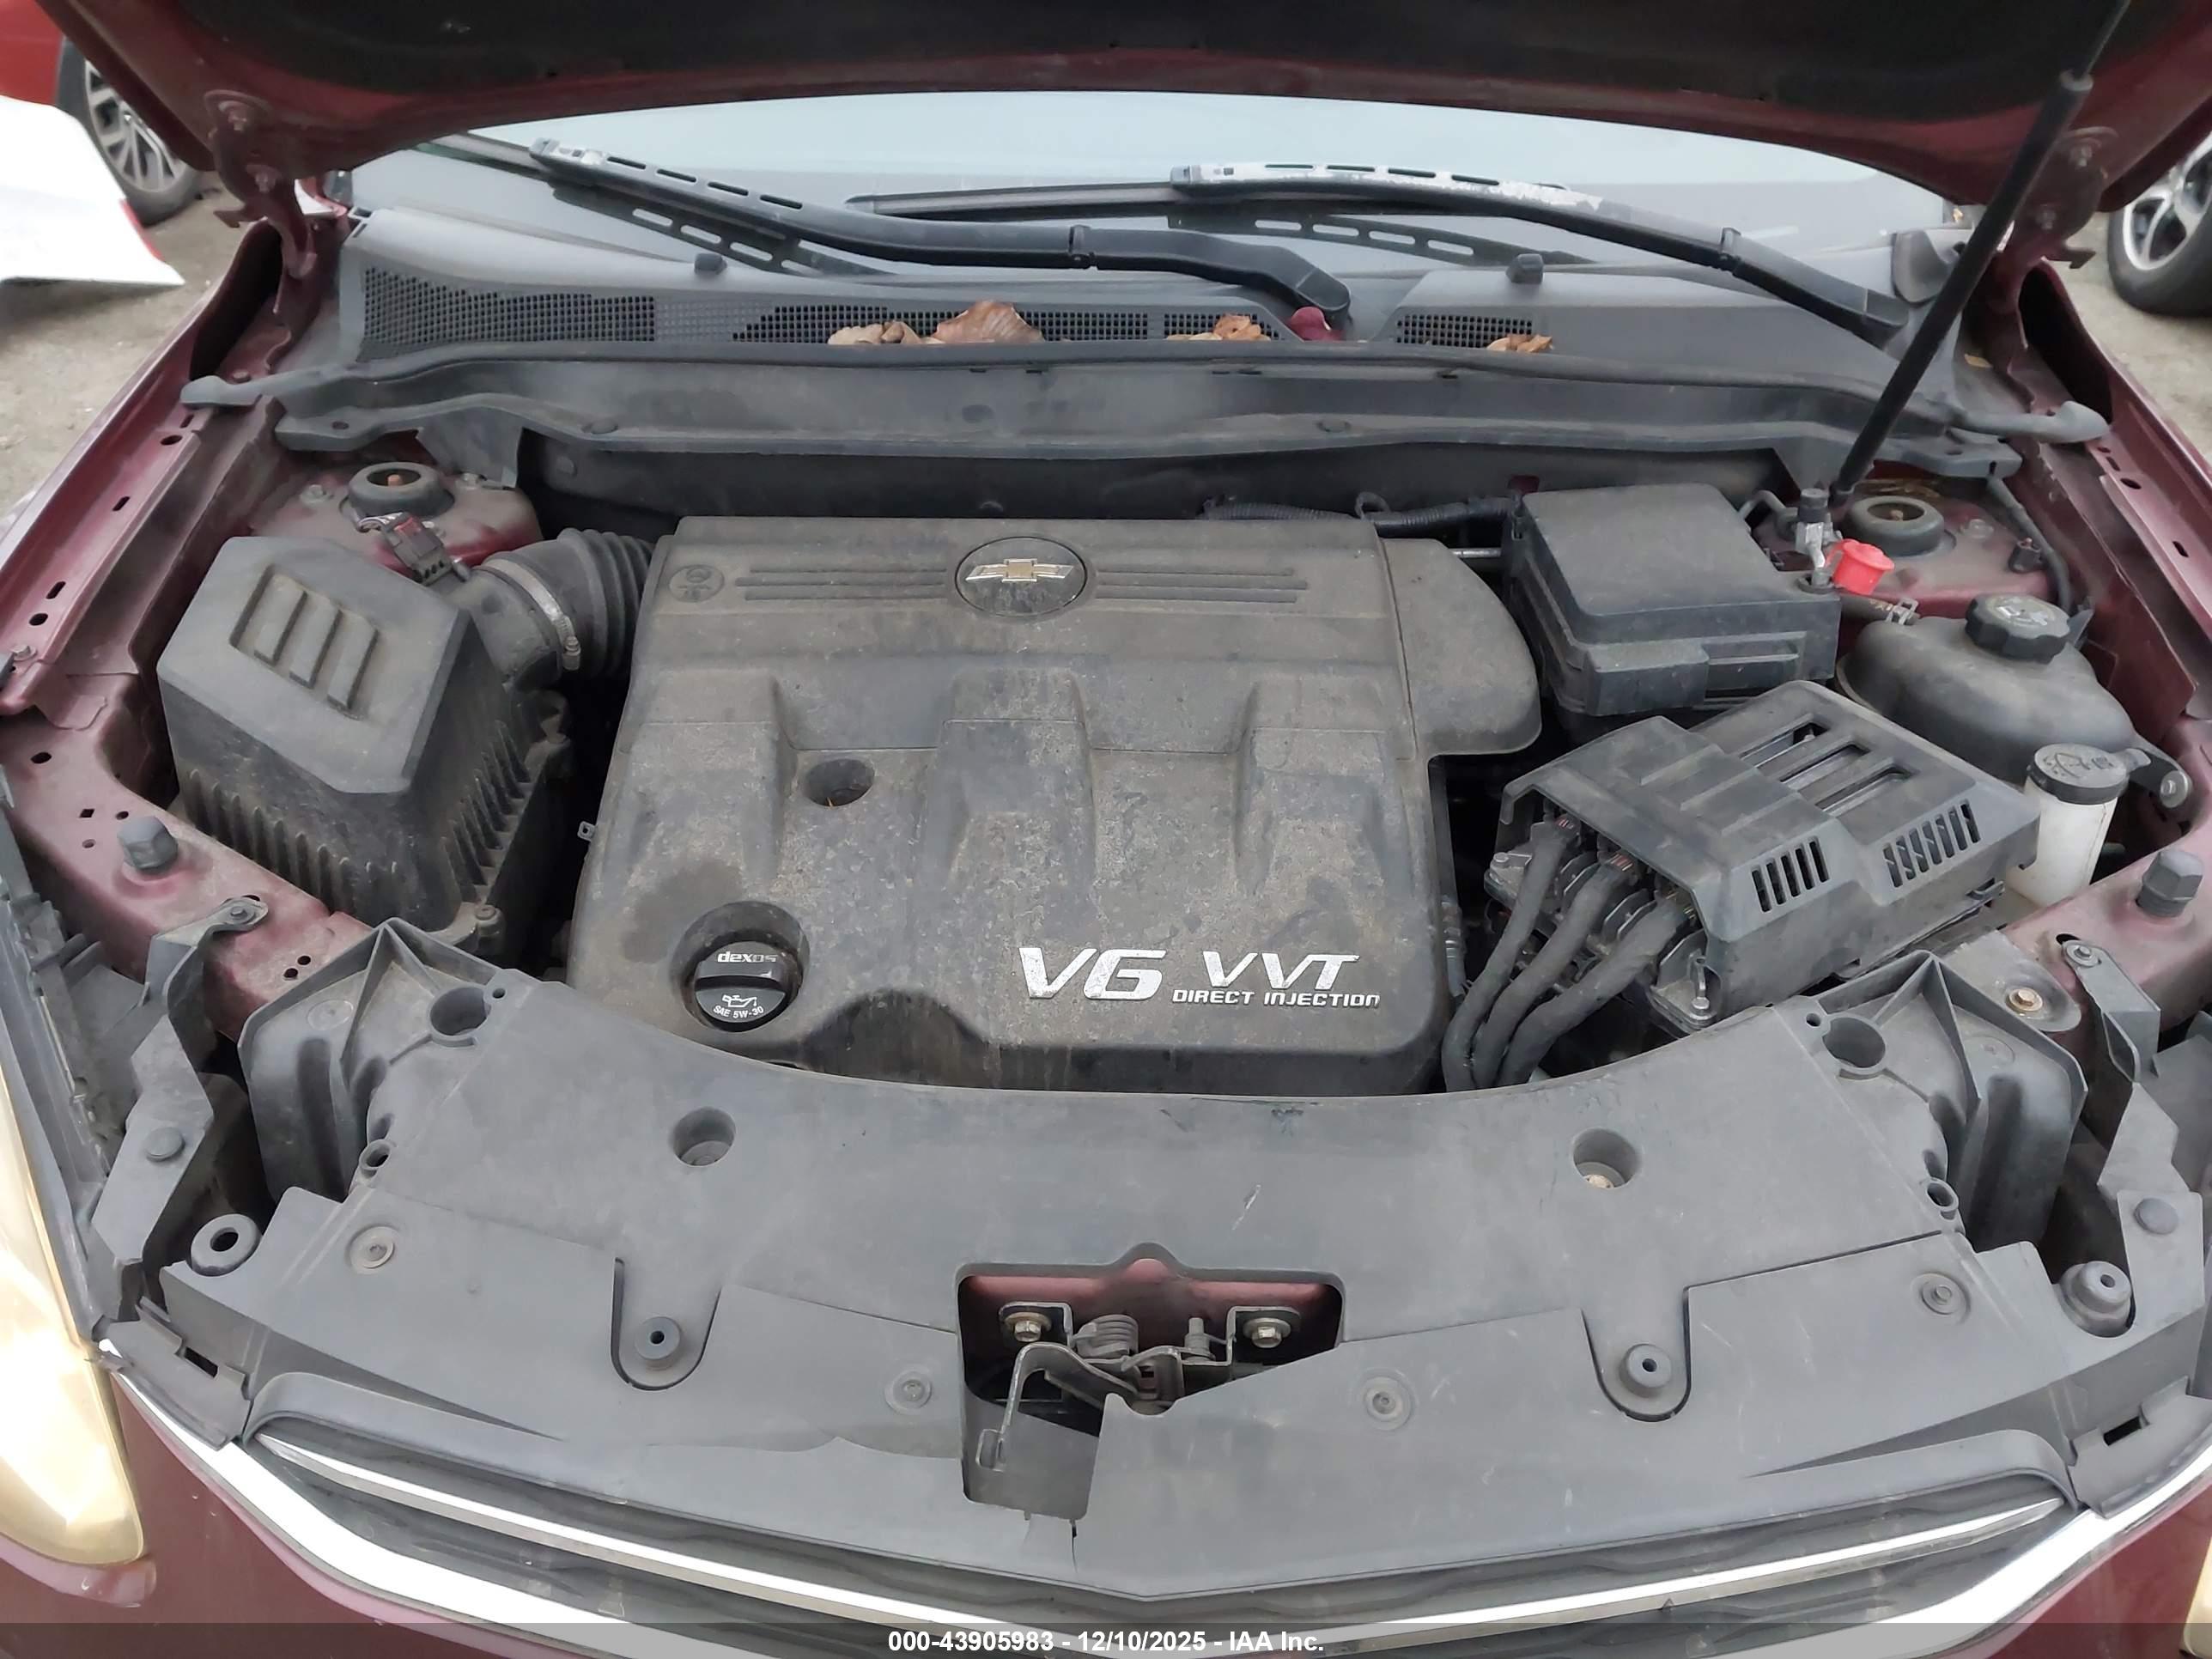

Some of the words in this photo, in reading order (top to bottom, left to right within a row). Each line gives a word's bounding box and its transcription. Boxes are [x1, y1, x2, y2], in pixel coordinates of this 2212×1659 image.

[717, 951, 778, 963] dexos
[1019, 947, 1167, 1000] V6
[1202, 951, 1360, 990] VVT
[1172, 989, 1255, 1006] DIRECT
[1263, 991, 1381, 1008] INJECTION
[713, 1005, 731, 1018] SAE
[732, 1006, 764, 1018] 5W-30
